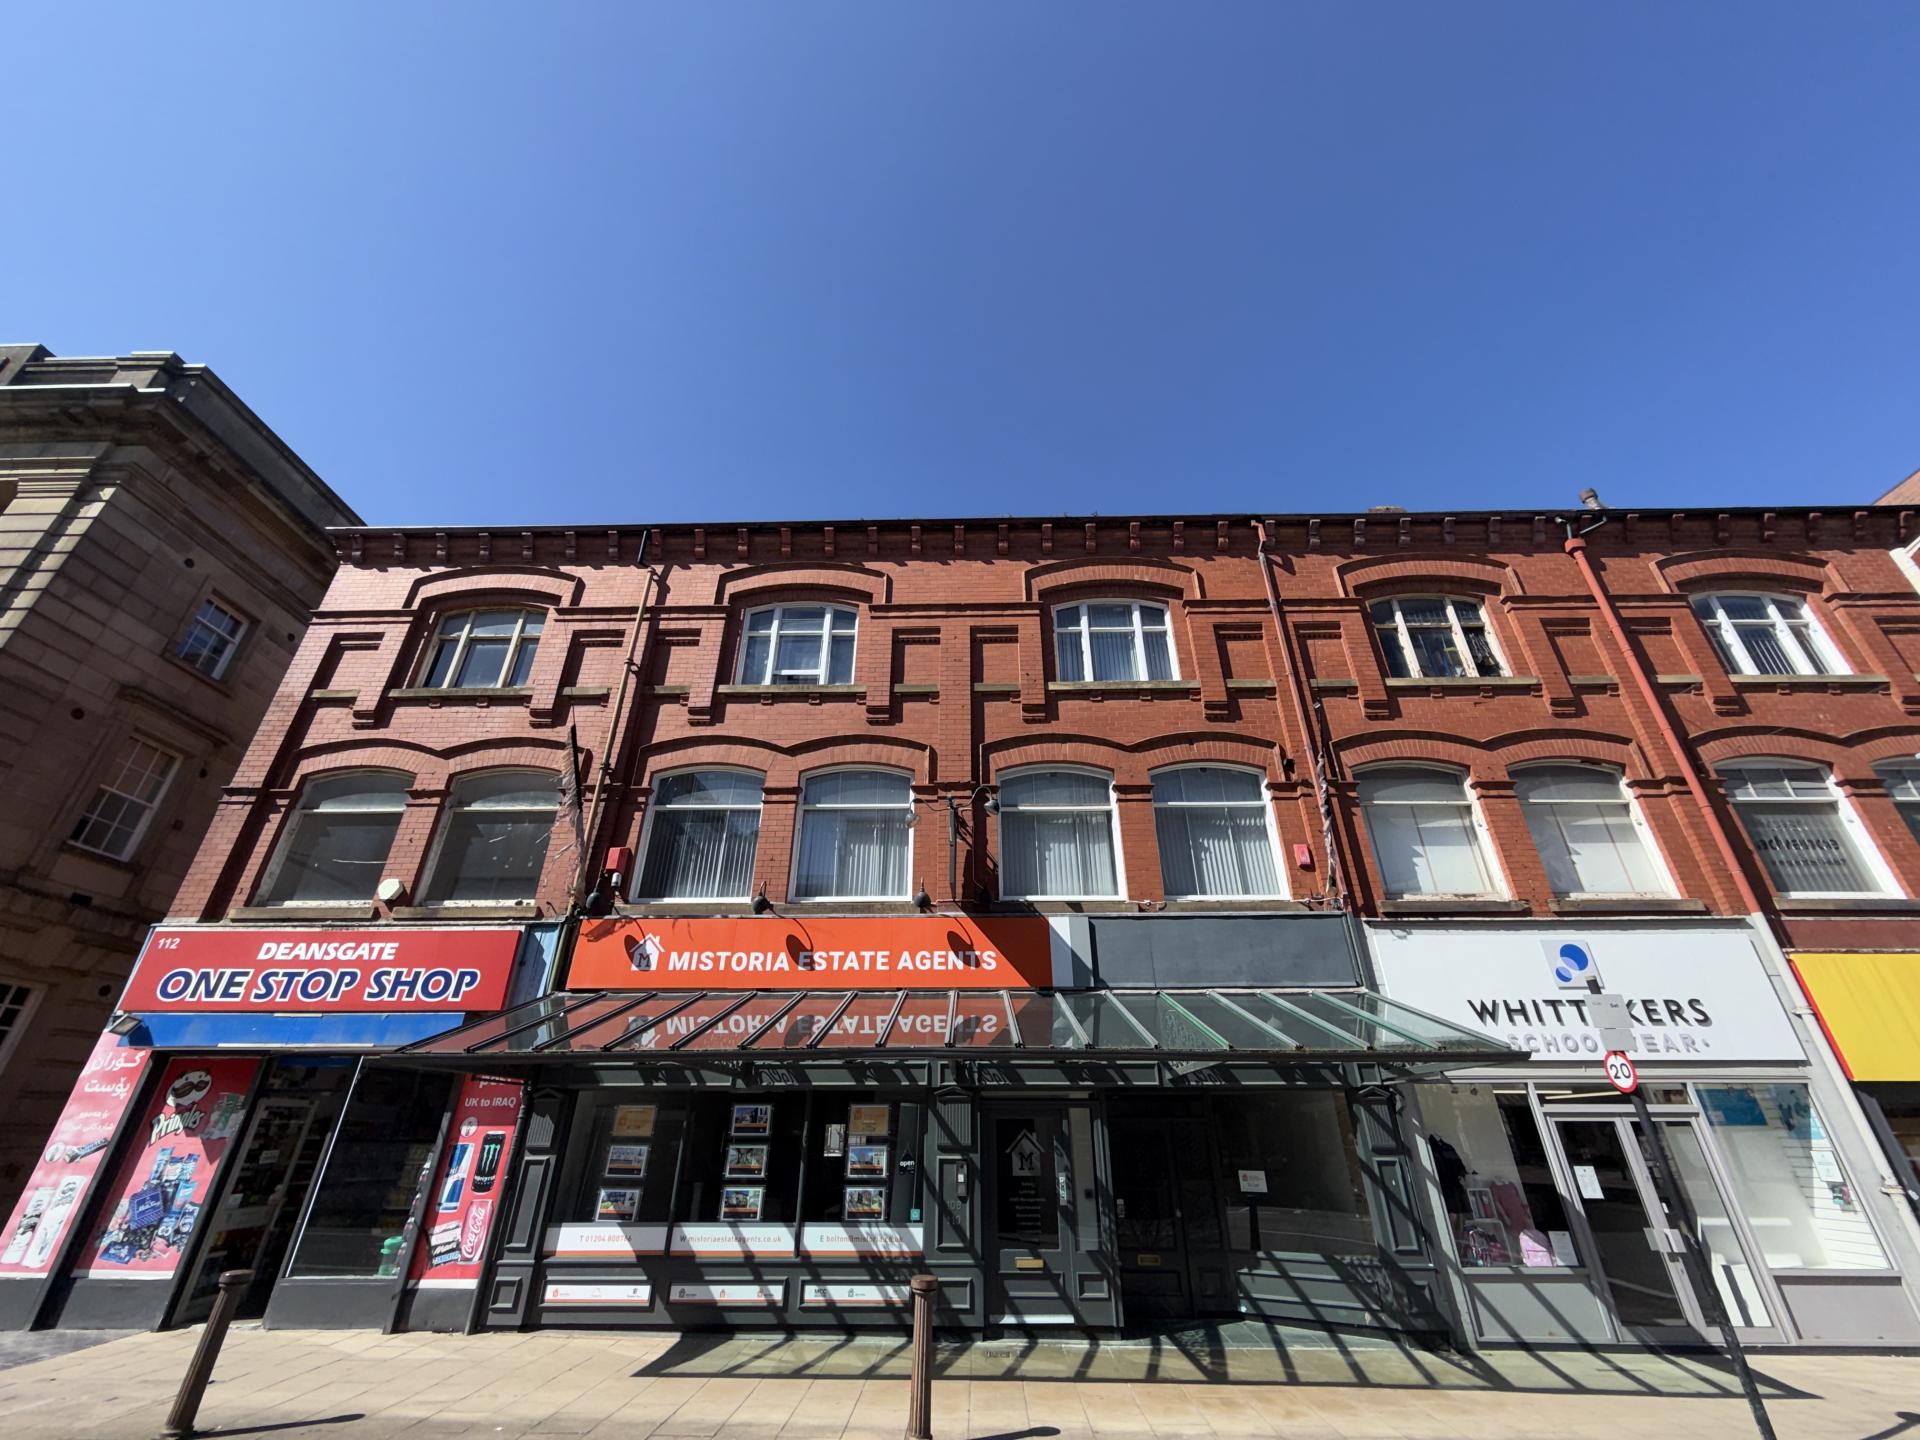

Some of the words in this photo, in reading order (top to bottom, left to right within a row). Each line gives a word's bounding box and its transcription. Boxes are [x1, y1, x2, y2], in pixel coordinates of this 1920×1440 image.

[157, 938, 180, 949] 112
[256, 942, 399, 961] DEANSGATE
[668, 951, 789, 972] MISTORIA
[797, 950, 890, 971] ESTATE
[896, 950, 997, 970] AGENTS
[157, 968, 254, 1002] ONE
[250, 968, 359, 1002] STOP
[363, 967, 480, 1002] SHOP
[1467, 999, 1712, 1027] WHITTKERS
[1507, 1033, 1702, 1053] SCHOOEAR
[1609, 1063, 1632, 1080] 20
[464, 1098, 478, 1107] UK
[480, 1098, 490, 1107] to
[492, 1097, 517, 1108] IRAQ
